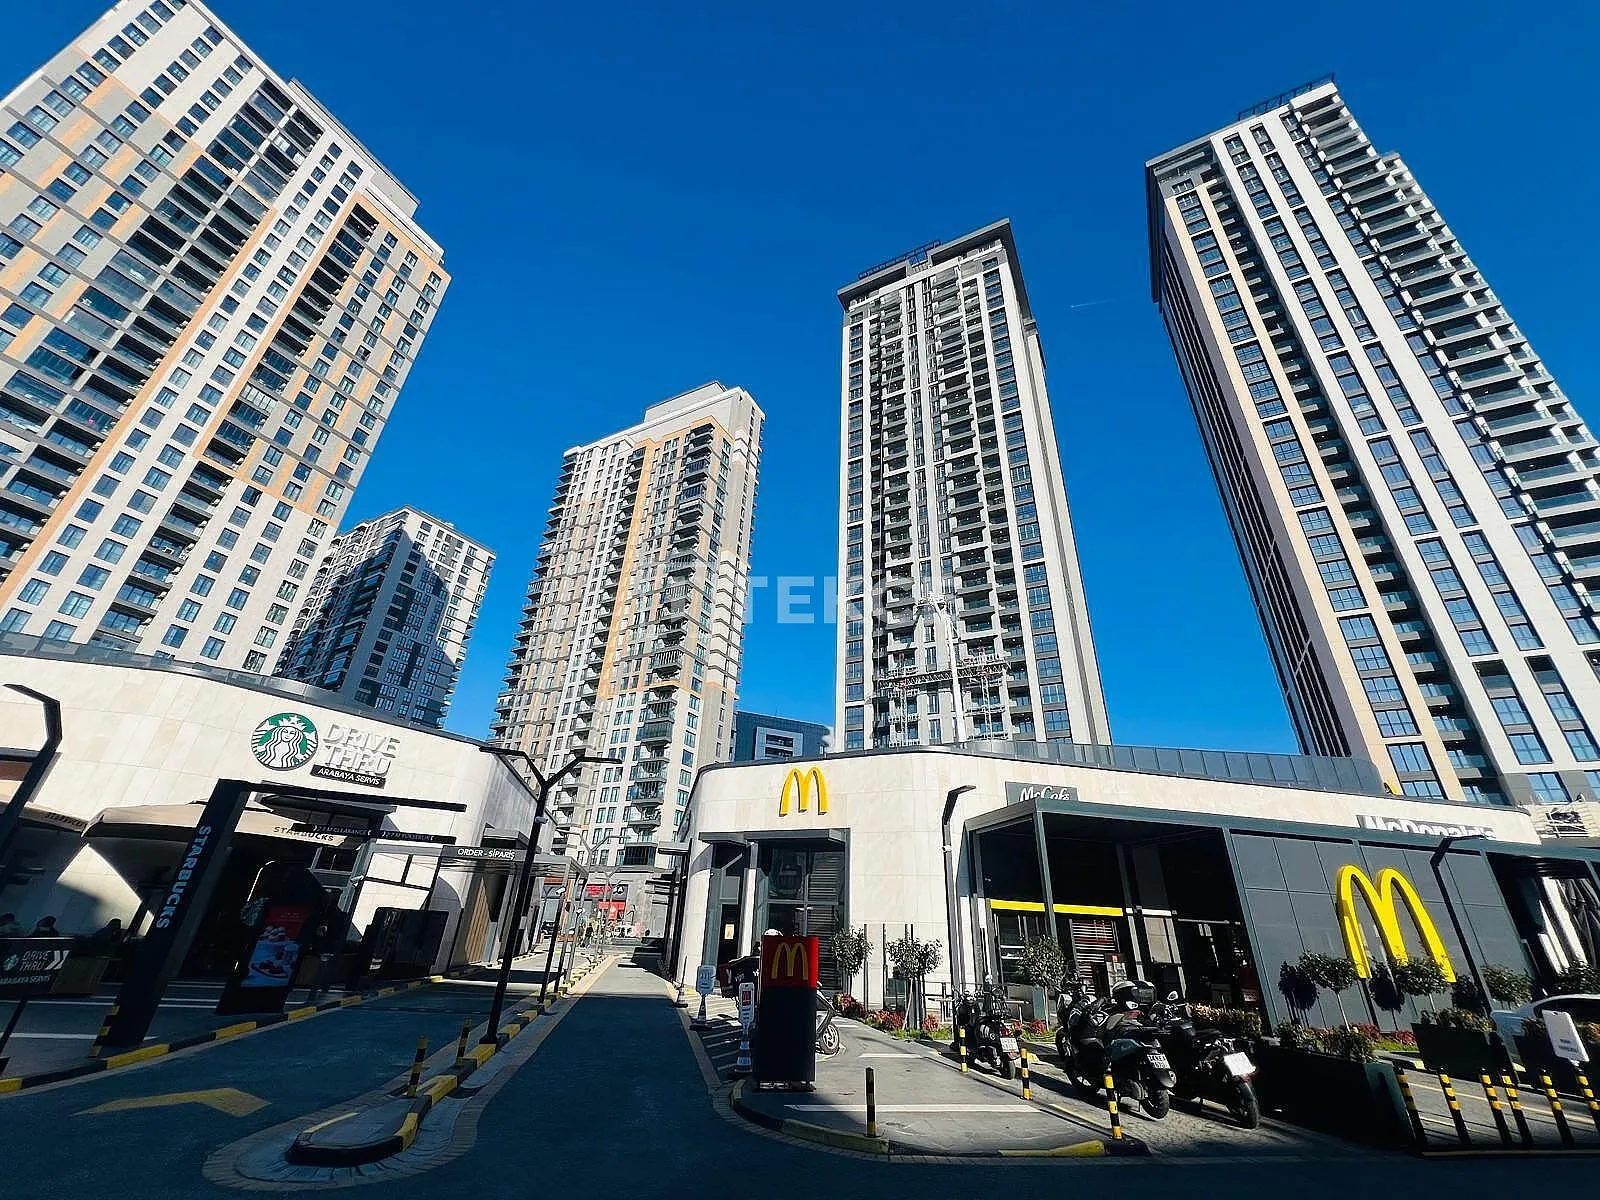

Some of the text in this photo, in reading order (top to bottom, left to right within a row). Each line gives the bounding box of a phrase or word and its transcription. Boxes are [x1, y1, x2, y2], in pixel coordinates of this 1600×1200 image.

[322, 724, 401, 759] DRIVE
[324, 745, 392, 777] THRU
[317, 767, 355, 781] ARABAYA
[457, 848, 483, 857] ORDER
[156, 825, 212, 929] STARBUCKS
[22, 950, 52, 961] DRIVE
[19, 960, 46, 971] THRU
